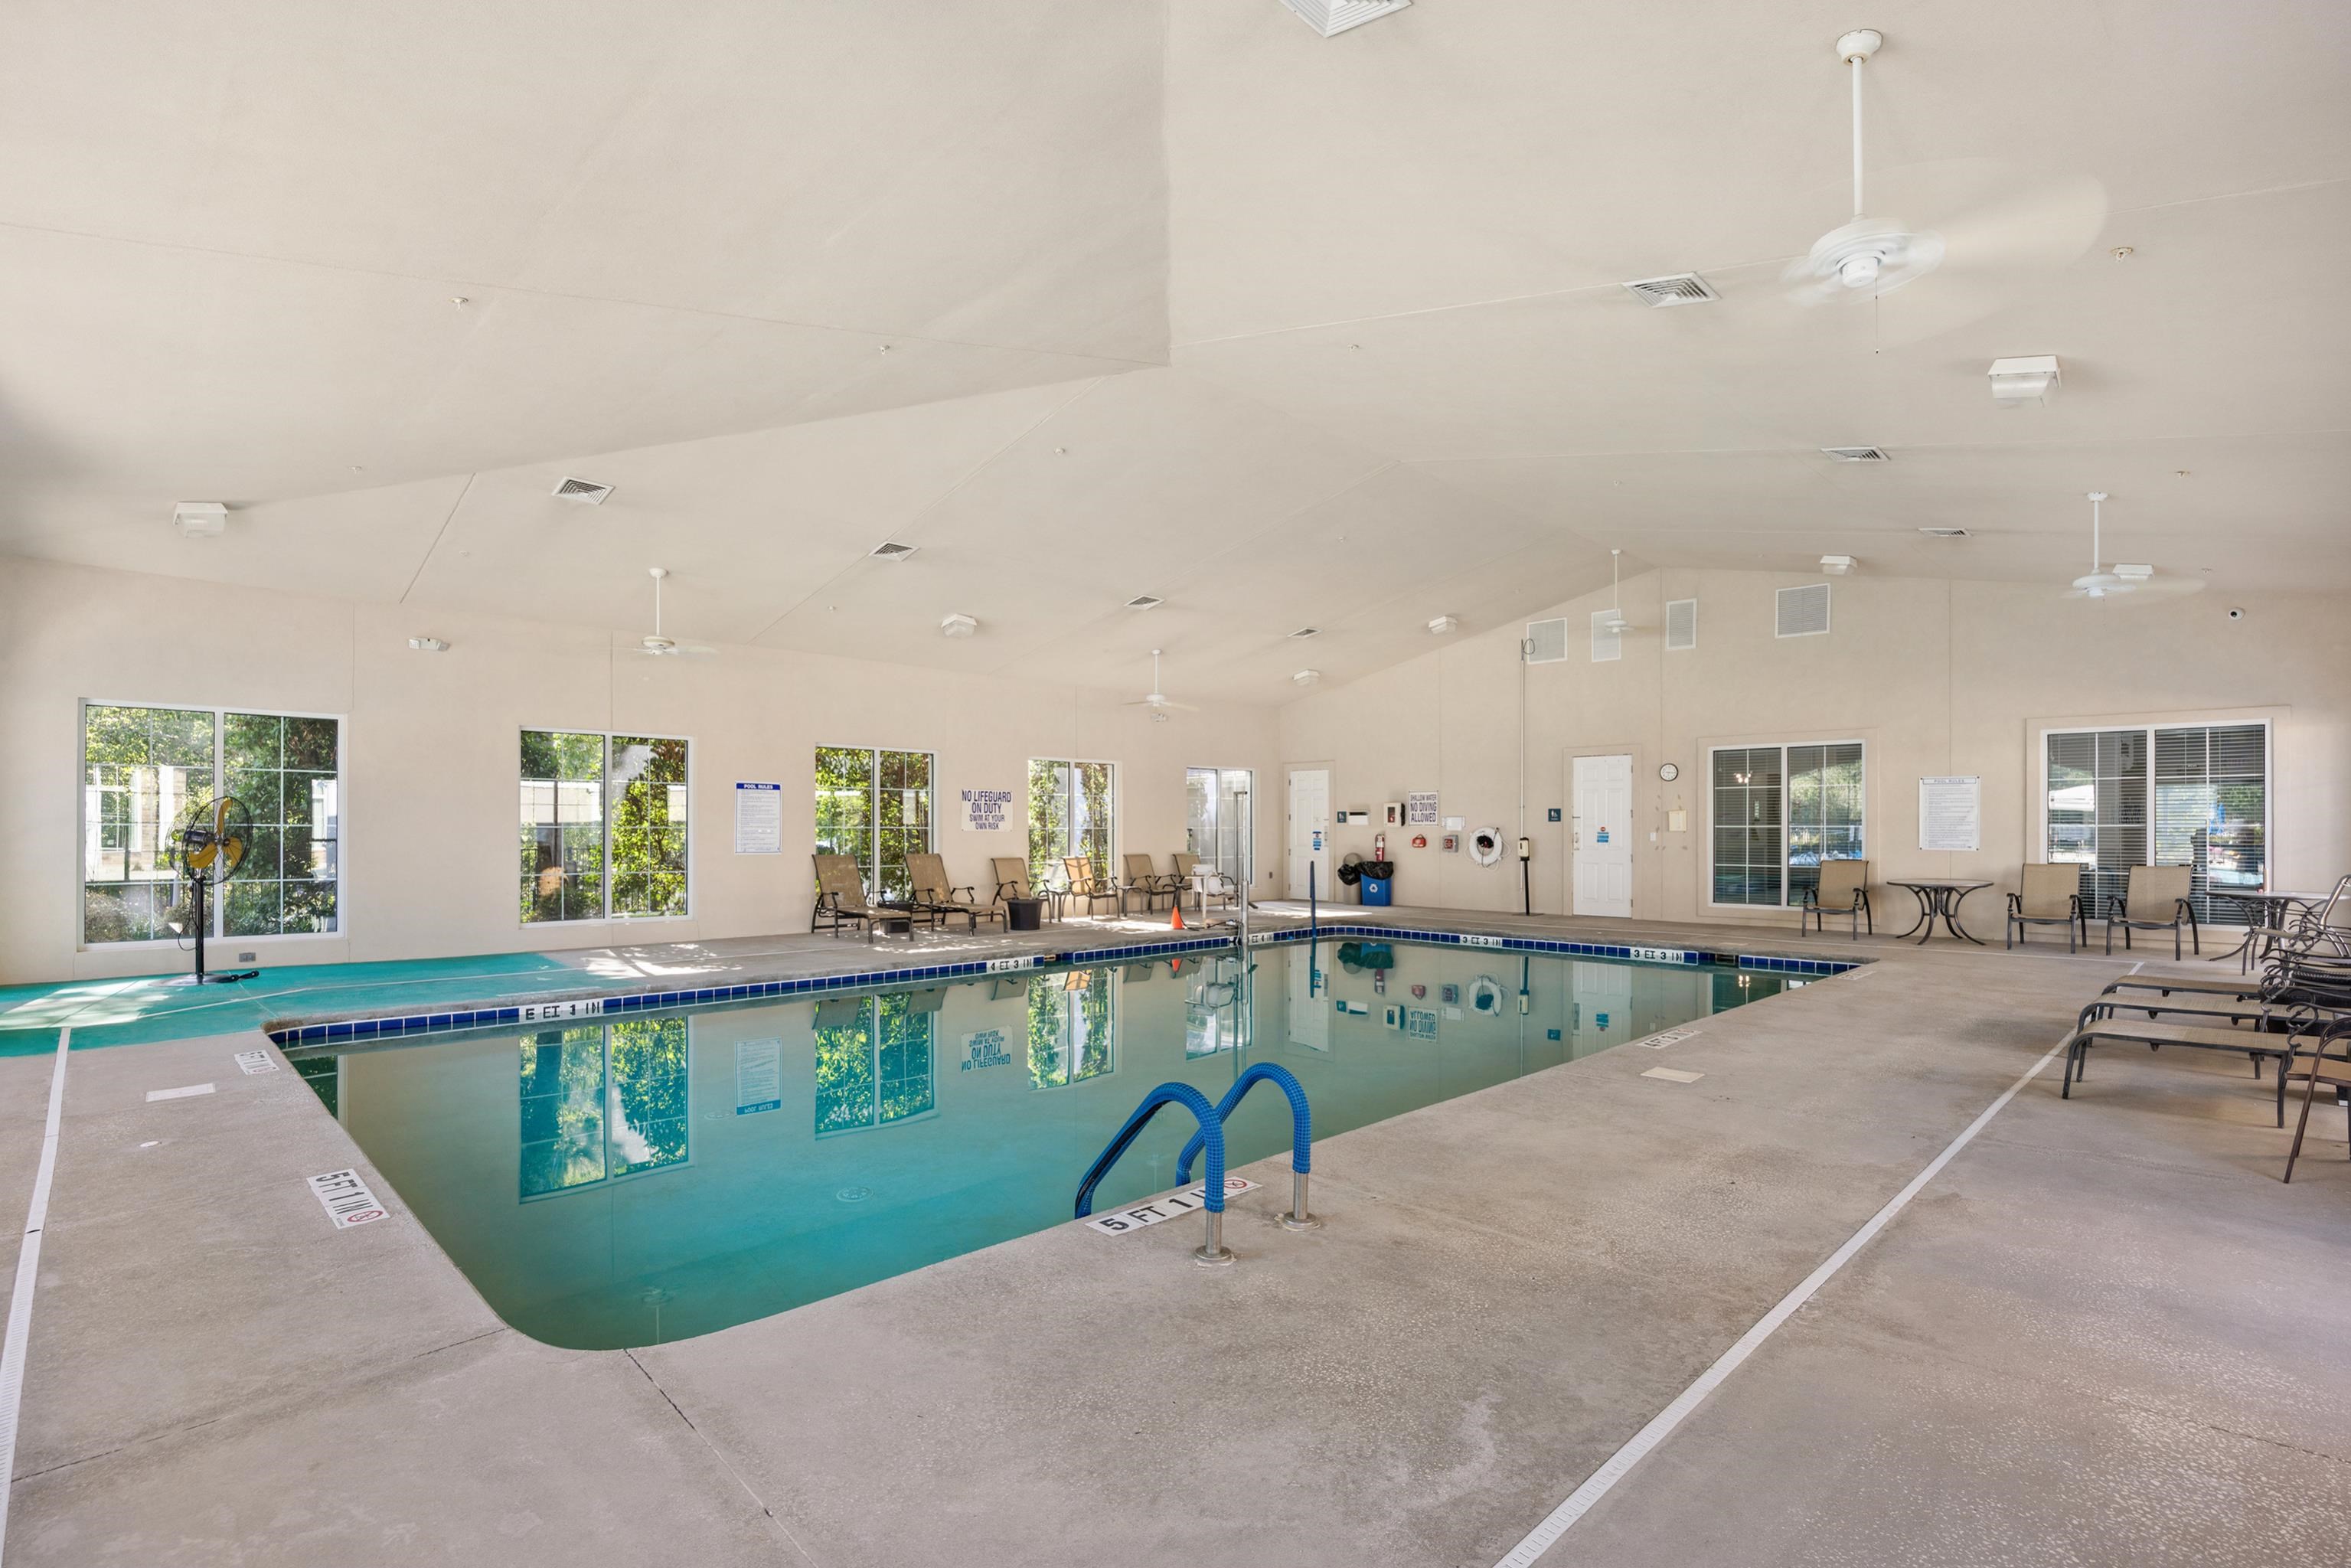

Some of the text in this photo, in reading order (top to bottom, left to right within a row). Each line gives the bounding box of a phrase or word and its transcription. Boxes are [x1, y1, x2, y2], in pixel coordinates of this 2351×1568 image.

[962, 789, 1011, 802] NO LIFEGUARD
[972, 802, 1002, 813] ON DUTY
[1410, 802, 1437, 812] NO DIVING
[969, 814, 984, 822] SWIM
[991, 814, 1005, 822] YOUR
[1411, 812, 1436, 822] ALLOWED
[975, 822, 987, 830] OWN
[315, 1171, 374, 1214] 5 FT 1 IN
[1099, 1218, 1129, 1230] 5
[1127, 1206, 1167, 1223] FT
[1168, 1198, 1193, 1208] 1
